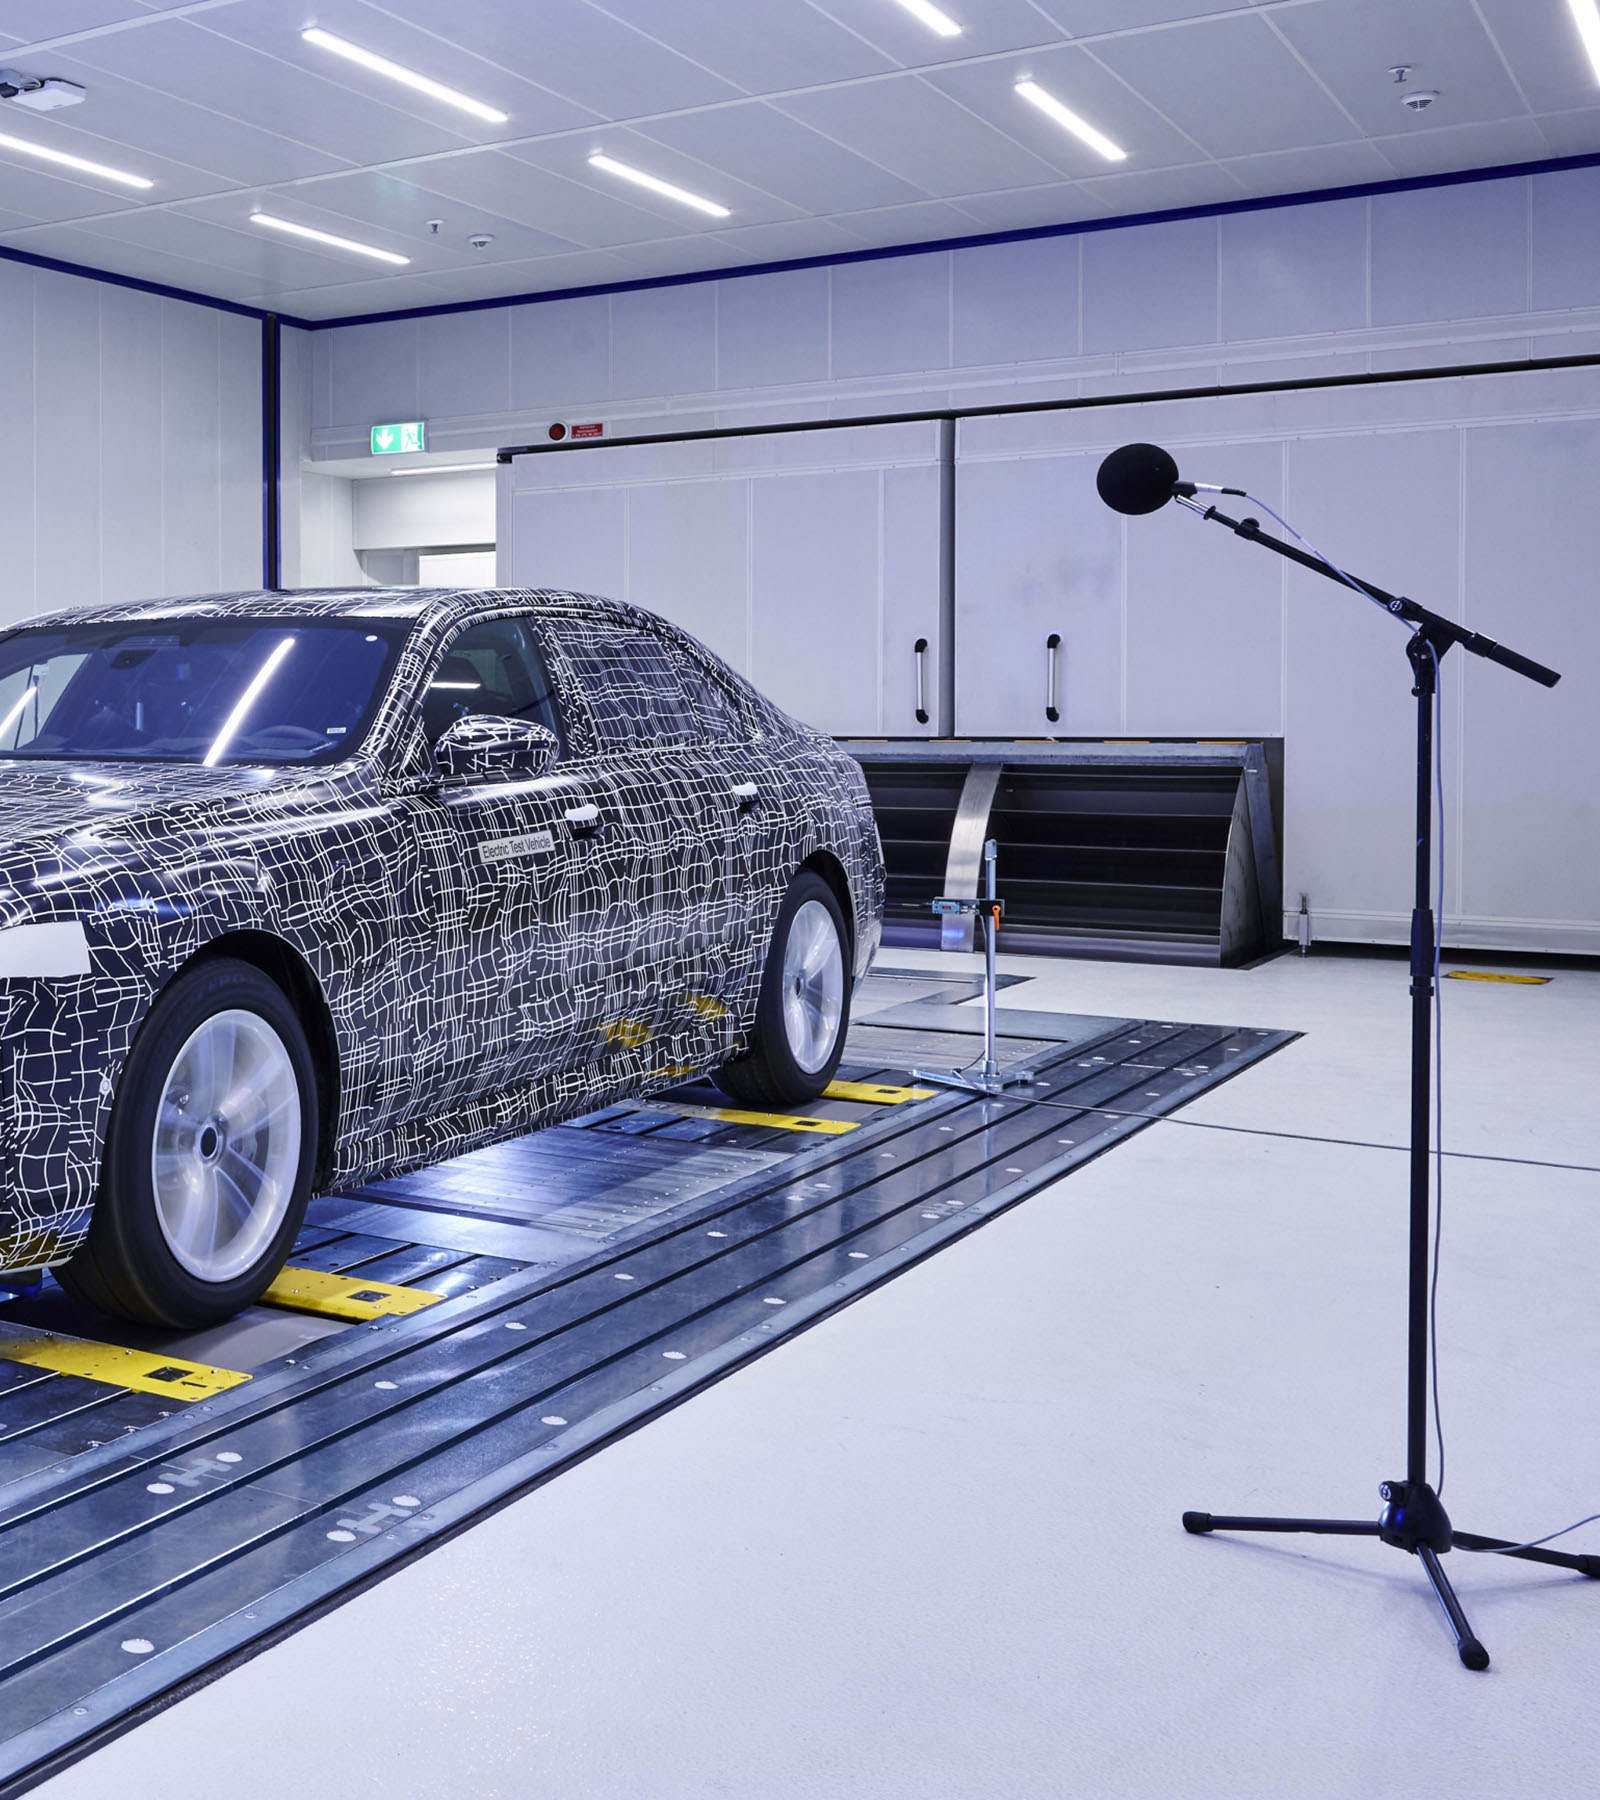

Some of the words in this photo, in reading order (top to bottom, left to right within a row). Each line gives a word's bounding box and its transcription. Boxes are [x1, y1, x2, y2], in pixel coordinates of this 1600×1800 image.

[482, 842, 510, 859] Electric
[509, 840, 526, 853] Test
[524, 835, 552, 851] Vehicle
